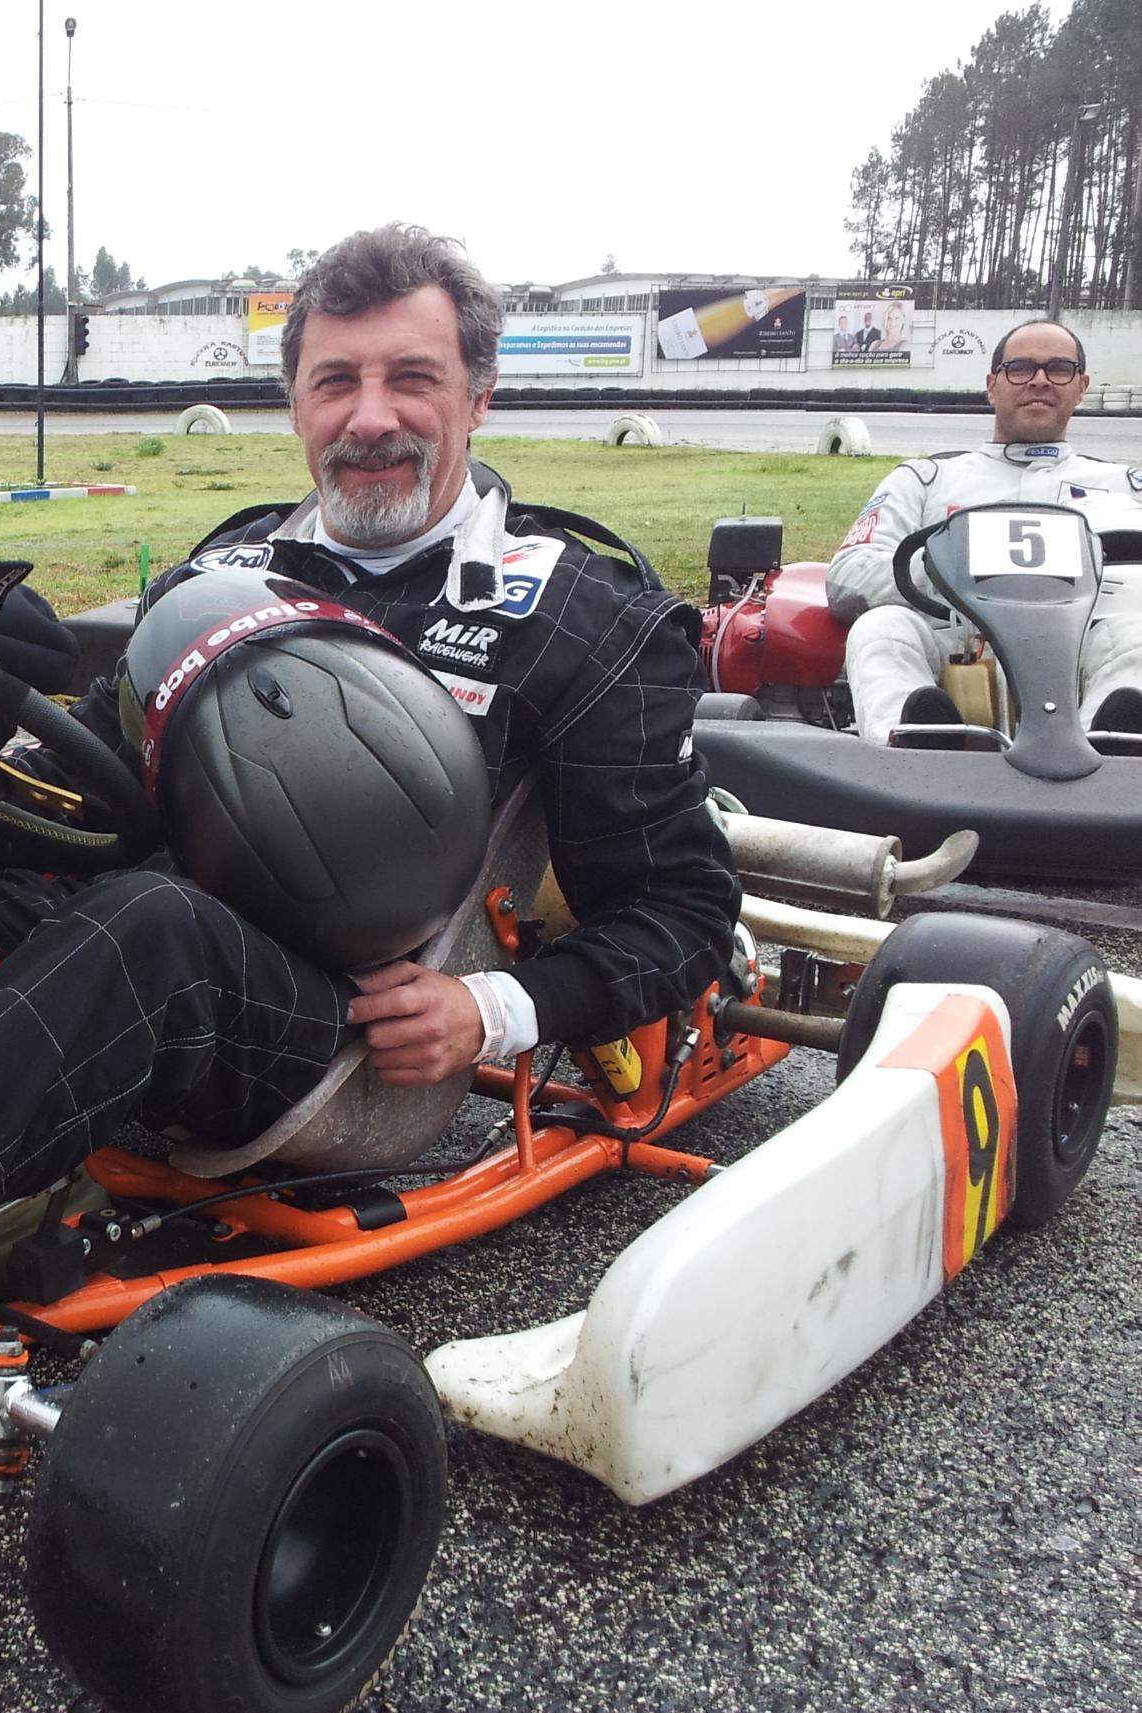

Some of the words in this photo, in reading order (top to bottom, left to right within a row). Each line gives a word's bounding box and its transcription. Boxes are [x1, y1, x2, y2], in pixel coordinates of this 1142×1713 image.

[1008, 519, 1046, 568] 5
[206, 600, 319, 648] clube
[419, 637, 490, 668] RACEWEAR
[154, 648, 207, 711] bcp
[448, 685, 487, 706] INDY
[1057, 965, 1098, 1032] MAXXIS
[963, 1049, 999, 1254] 9
